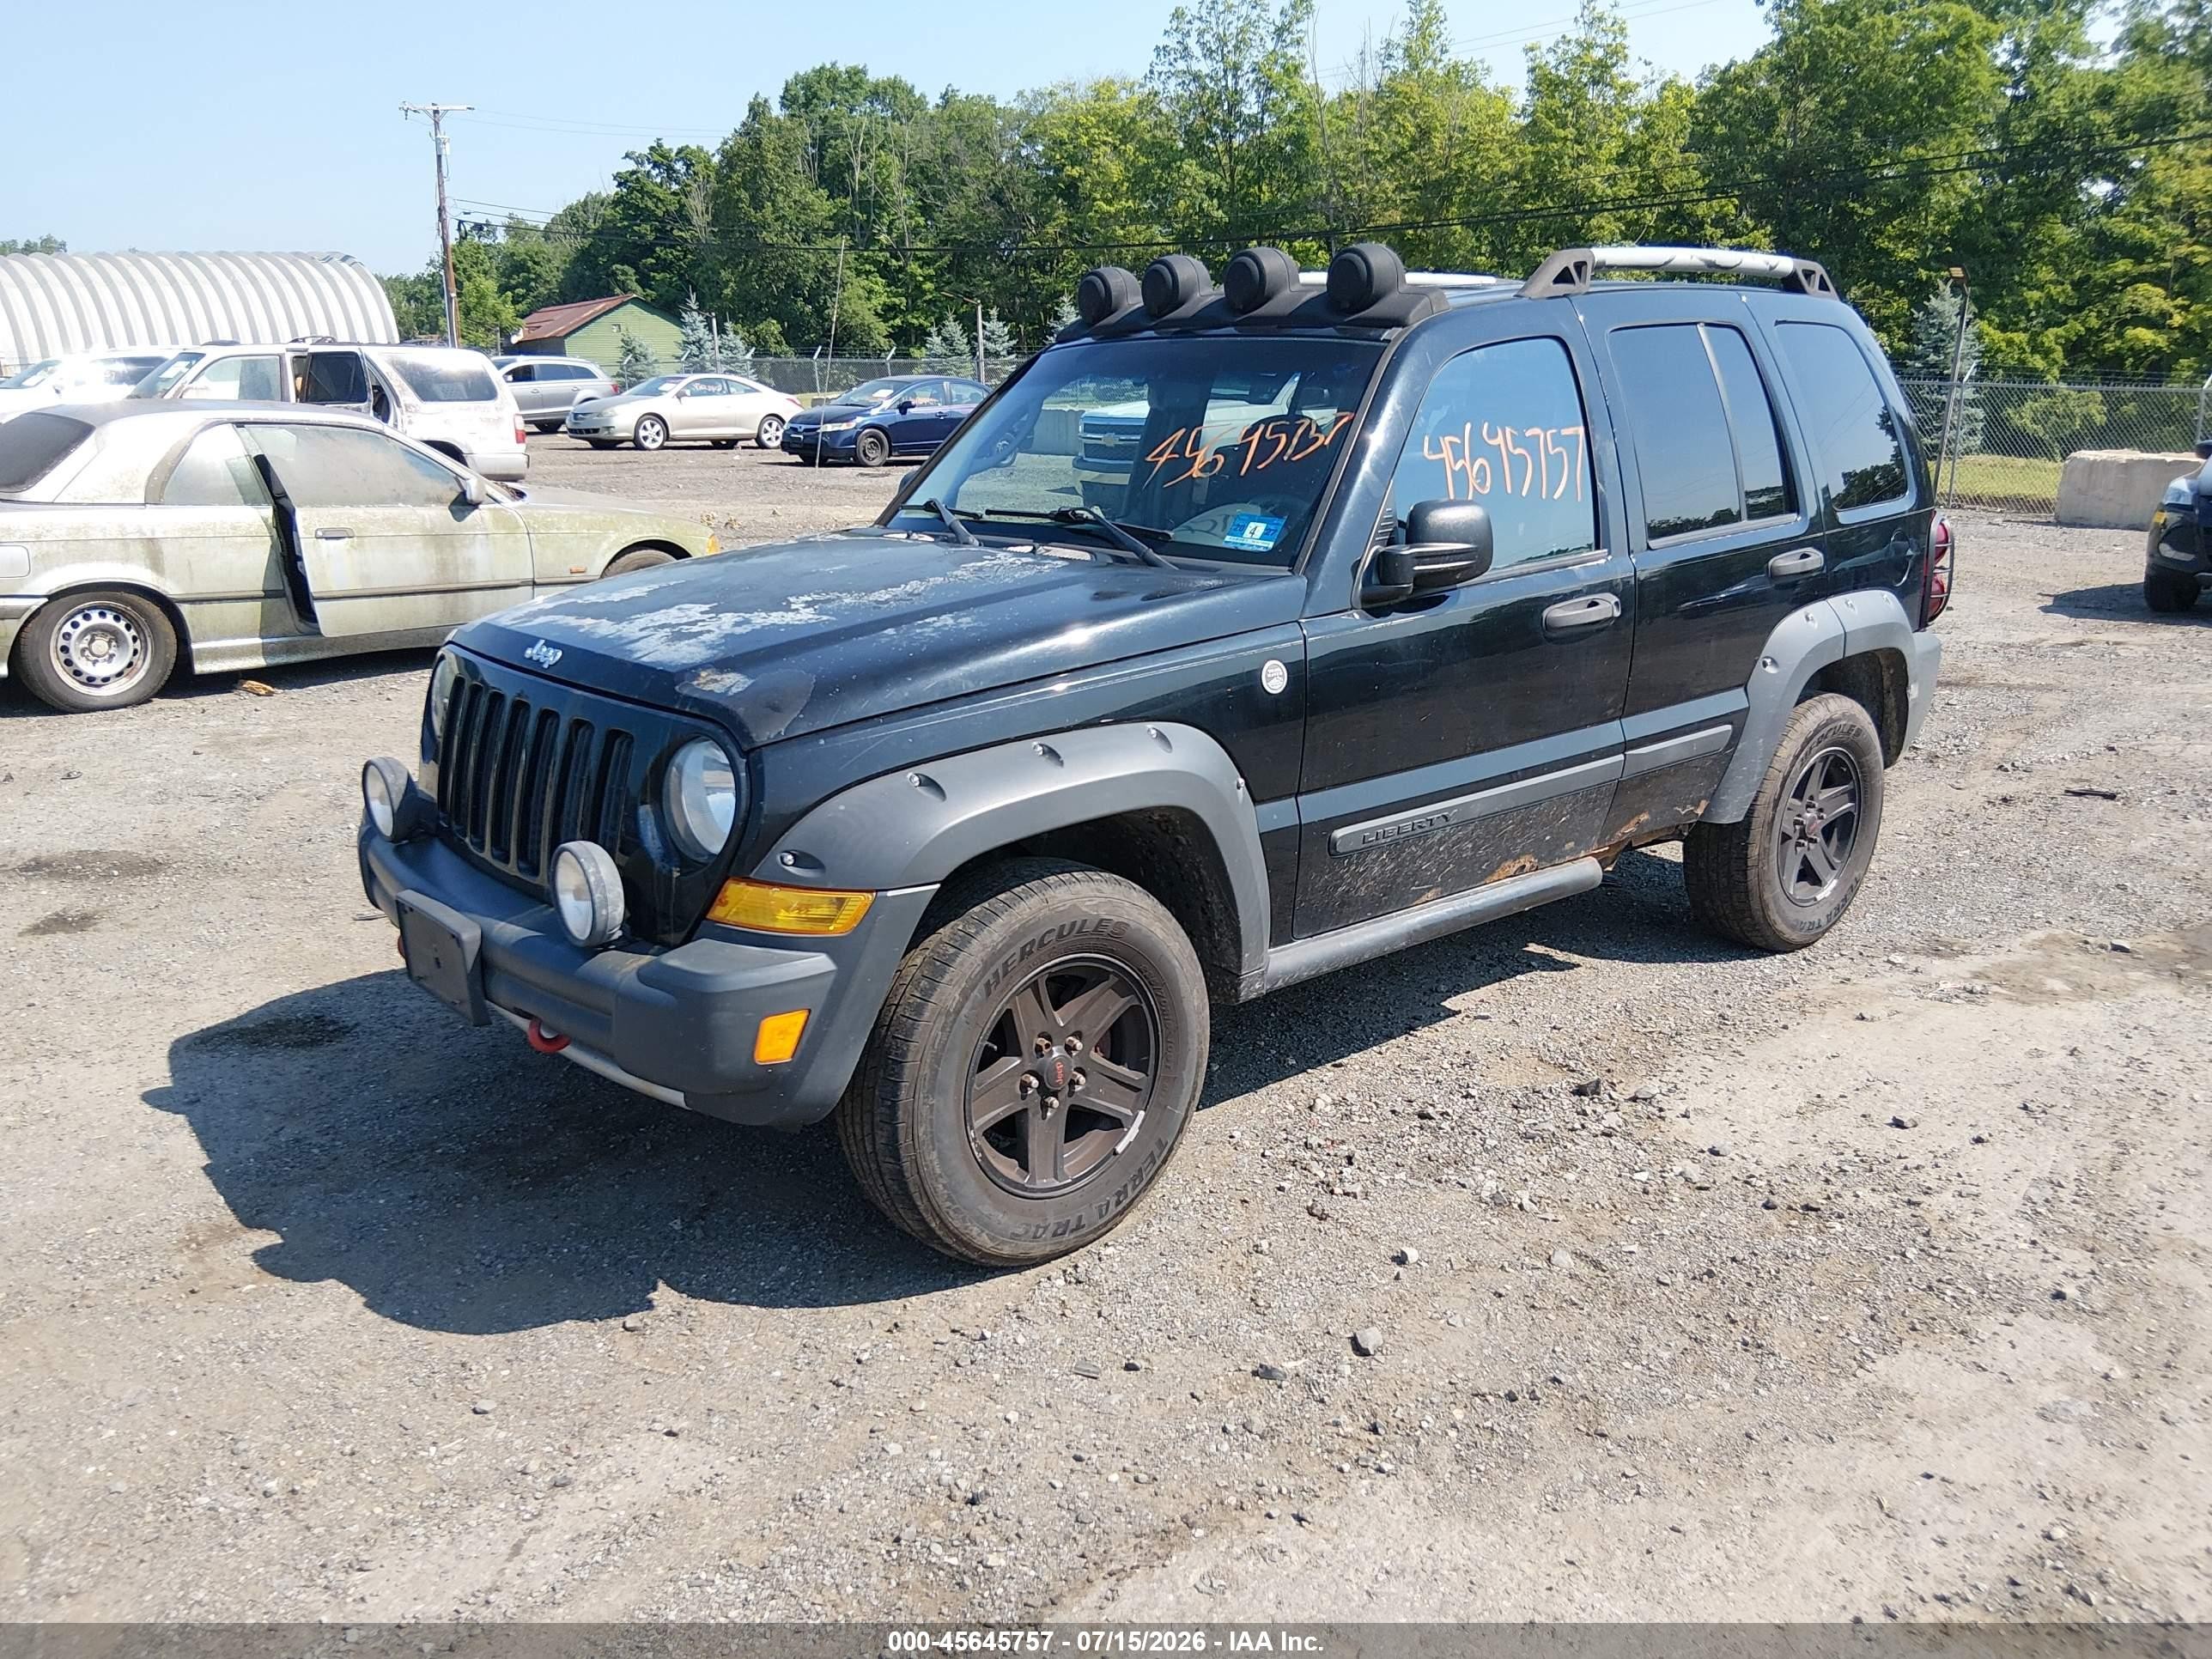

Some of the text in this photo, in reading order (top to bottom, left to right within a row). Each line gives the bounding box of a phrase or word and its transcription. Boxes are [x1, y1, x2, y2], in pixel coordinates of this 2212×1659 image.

[1424, 422, 1584, 501] 45645757
[1249, 526, 1259, 538] 4
[525, 639, 563, 669] Jeep
[1362, 809, 1458, 844] LIBERTY
[983, 917, 1131, 999] HERCULES
[1009, 1137, 1169, 1239] TERRA TRAC
